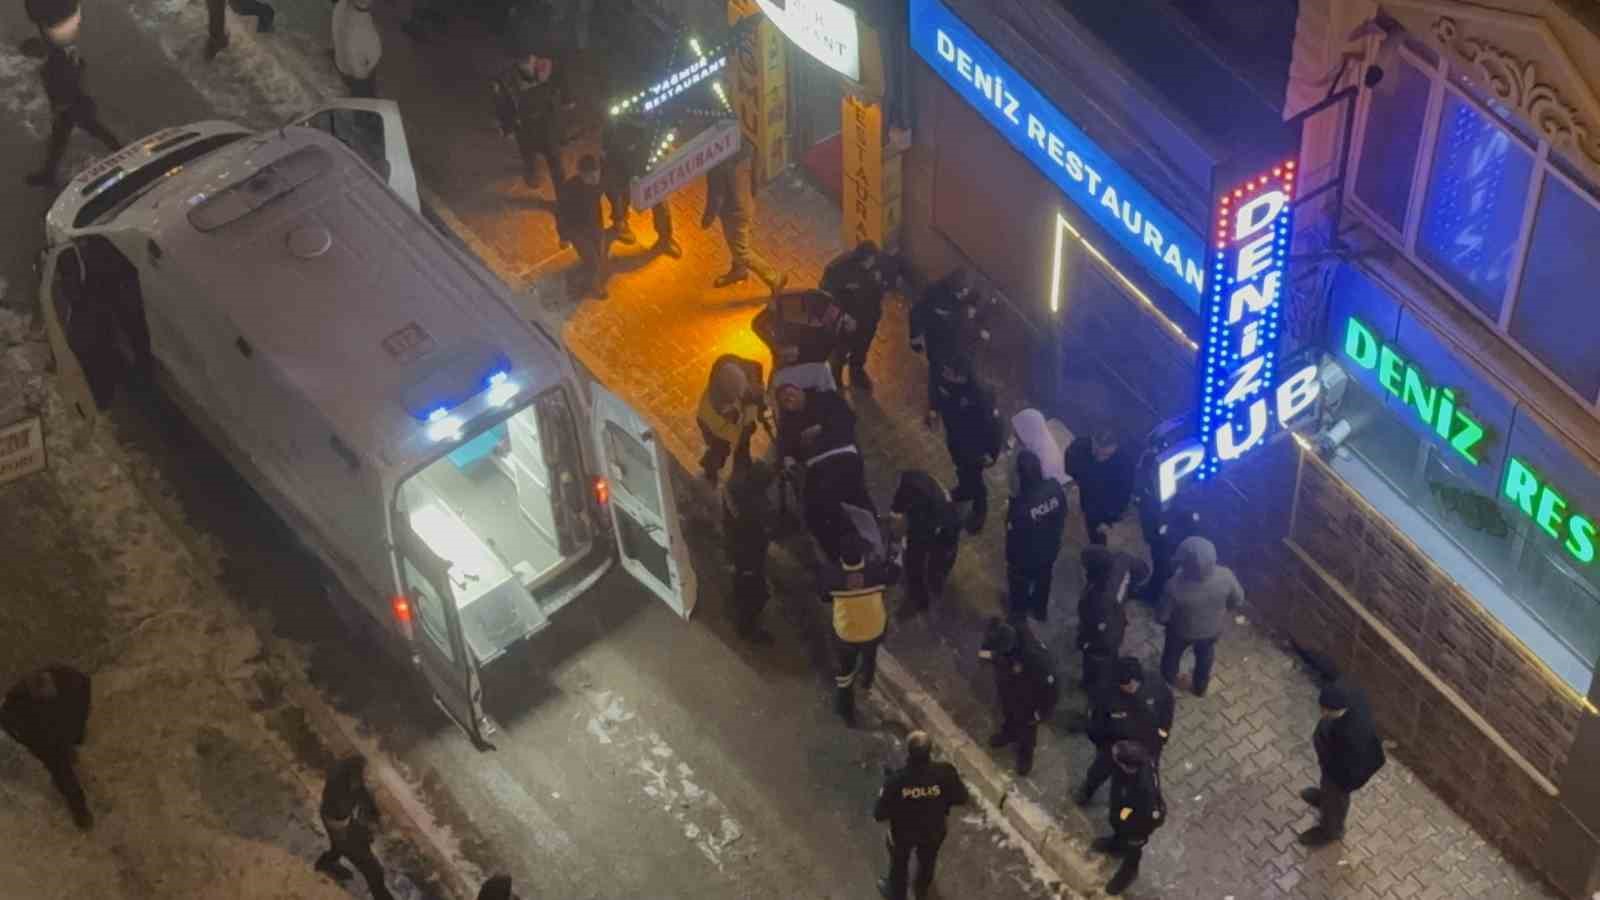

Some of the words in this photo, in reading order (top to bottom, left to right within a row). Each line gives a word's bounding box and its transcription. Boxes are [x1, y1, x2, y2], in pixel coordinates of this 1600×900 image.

[642, 134, 732, 199] RESTAURANT
[644, 57, 727, 111] RESTAURANT
[937, 28, 1020, 125] DENİZ
[1028, 113, 1205, 294] RESTAURAN
[1224, 190, 1285, 405] DENİZ
[1158, 364, 1321, 504] PUB
[1344, 316, 1485, 467] DENİZ
[1505, 456, 1596, 563] RES
